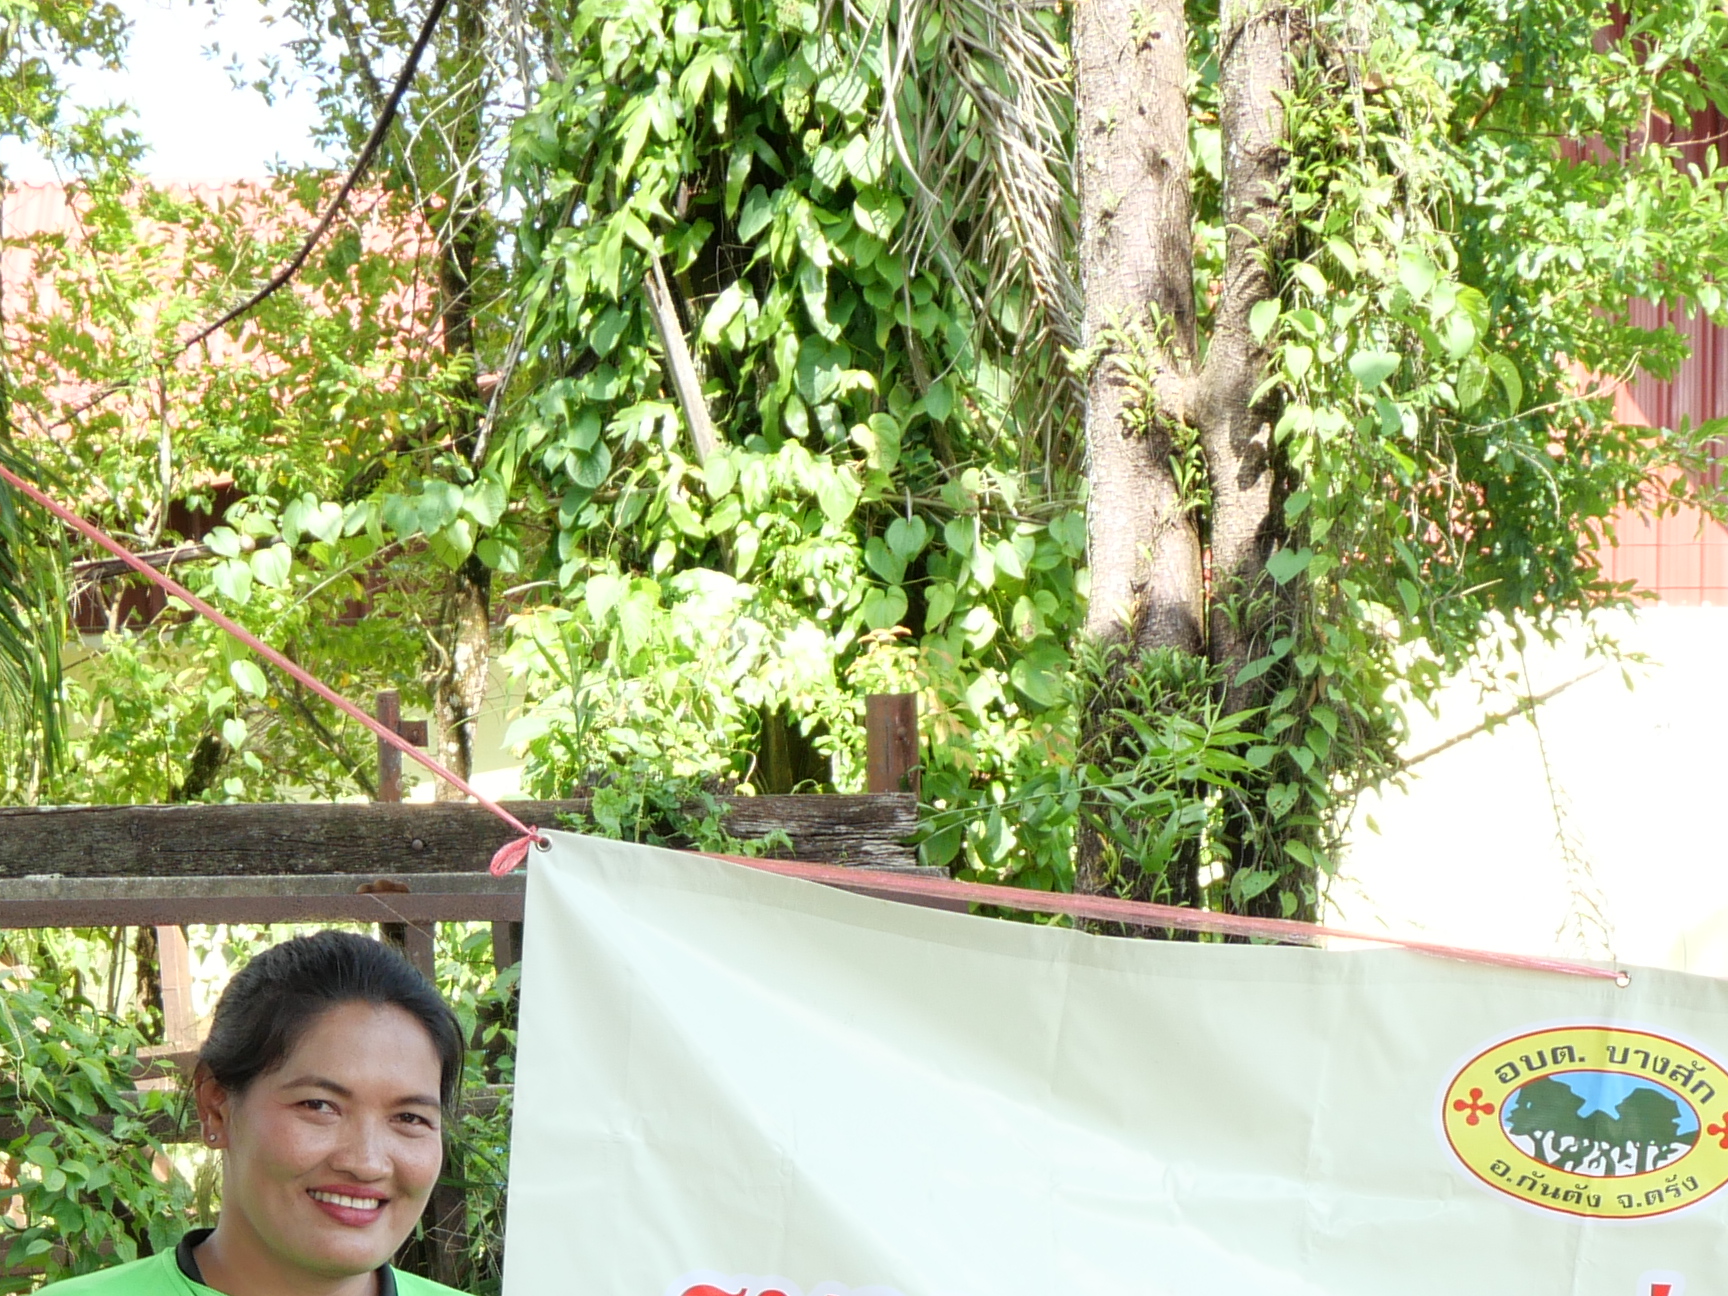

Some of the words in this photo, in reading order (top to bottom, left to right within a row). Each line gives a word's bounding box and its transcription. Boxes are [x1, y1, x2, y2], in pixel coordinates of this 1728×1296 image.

[1493, 1043, 1586, 1085] อบต.
[1605, 1044, 1716, 1105] บางสัก
[1489, 1158, 1602, 1208] อ.กันตัง
[1616, 1173, 1700, 1209] จ.ตรัง
